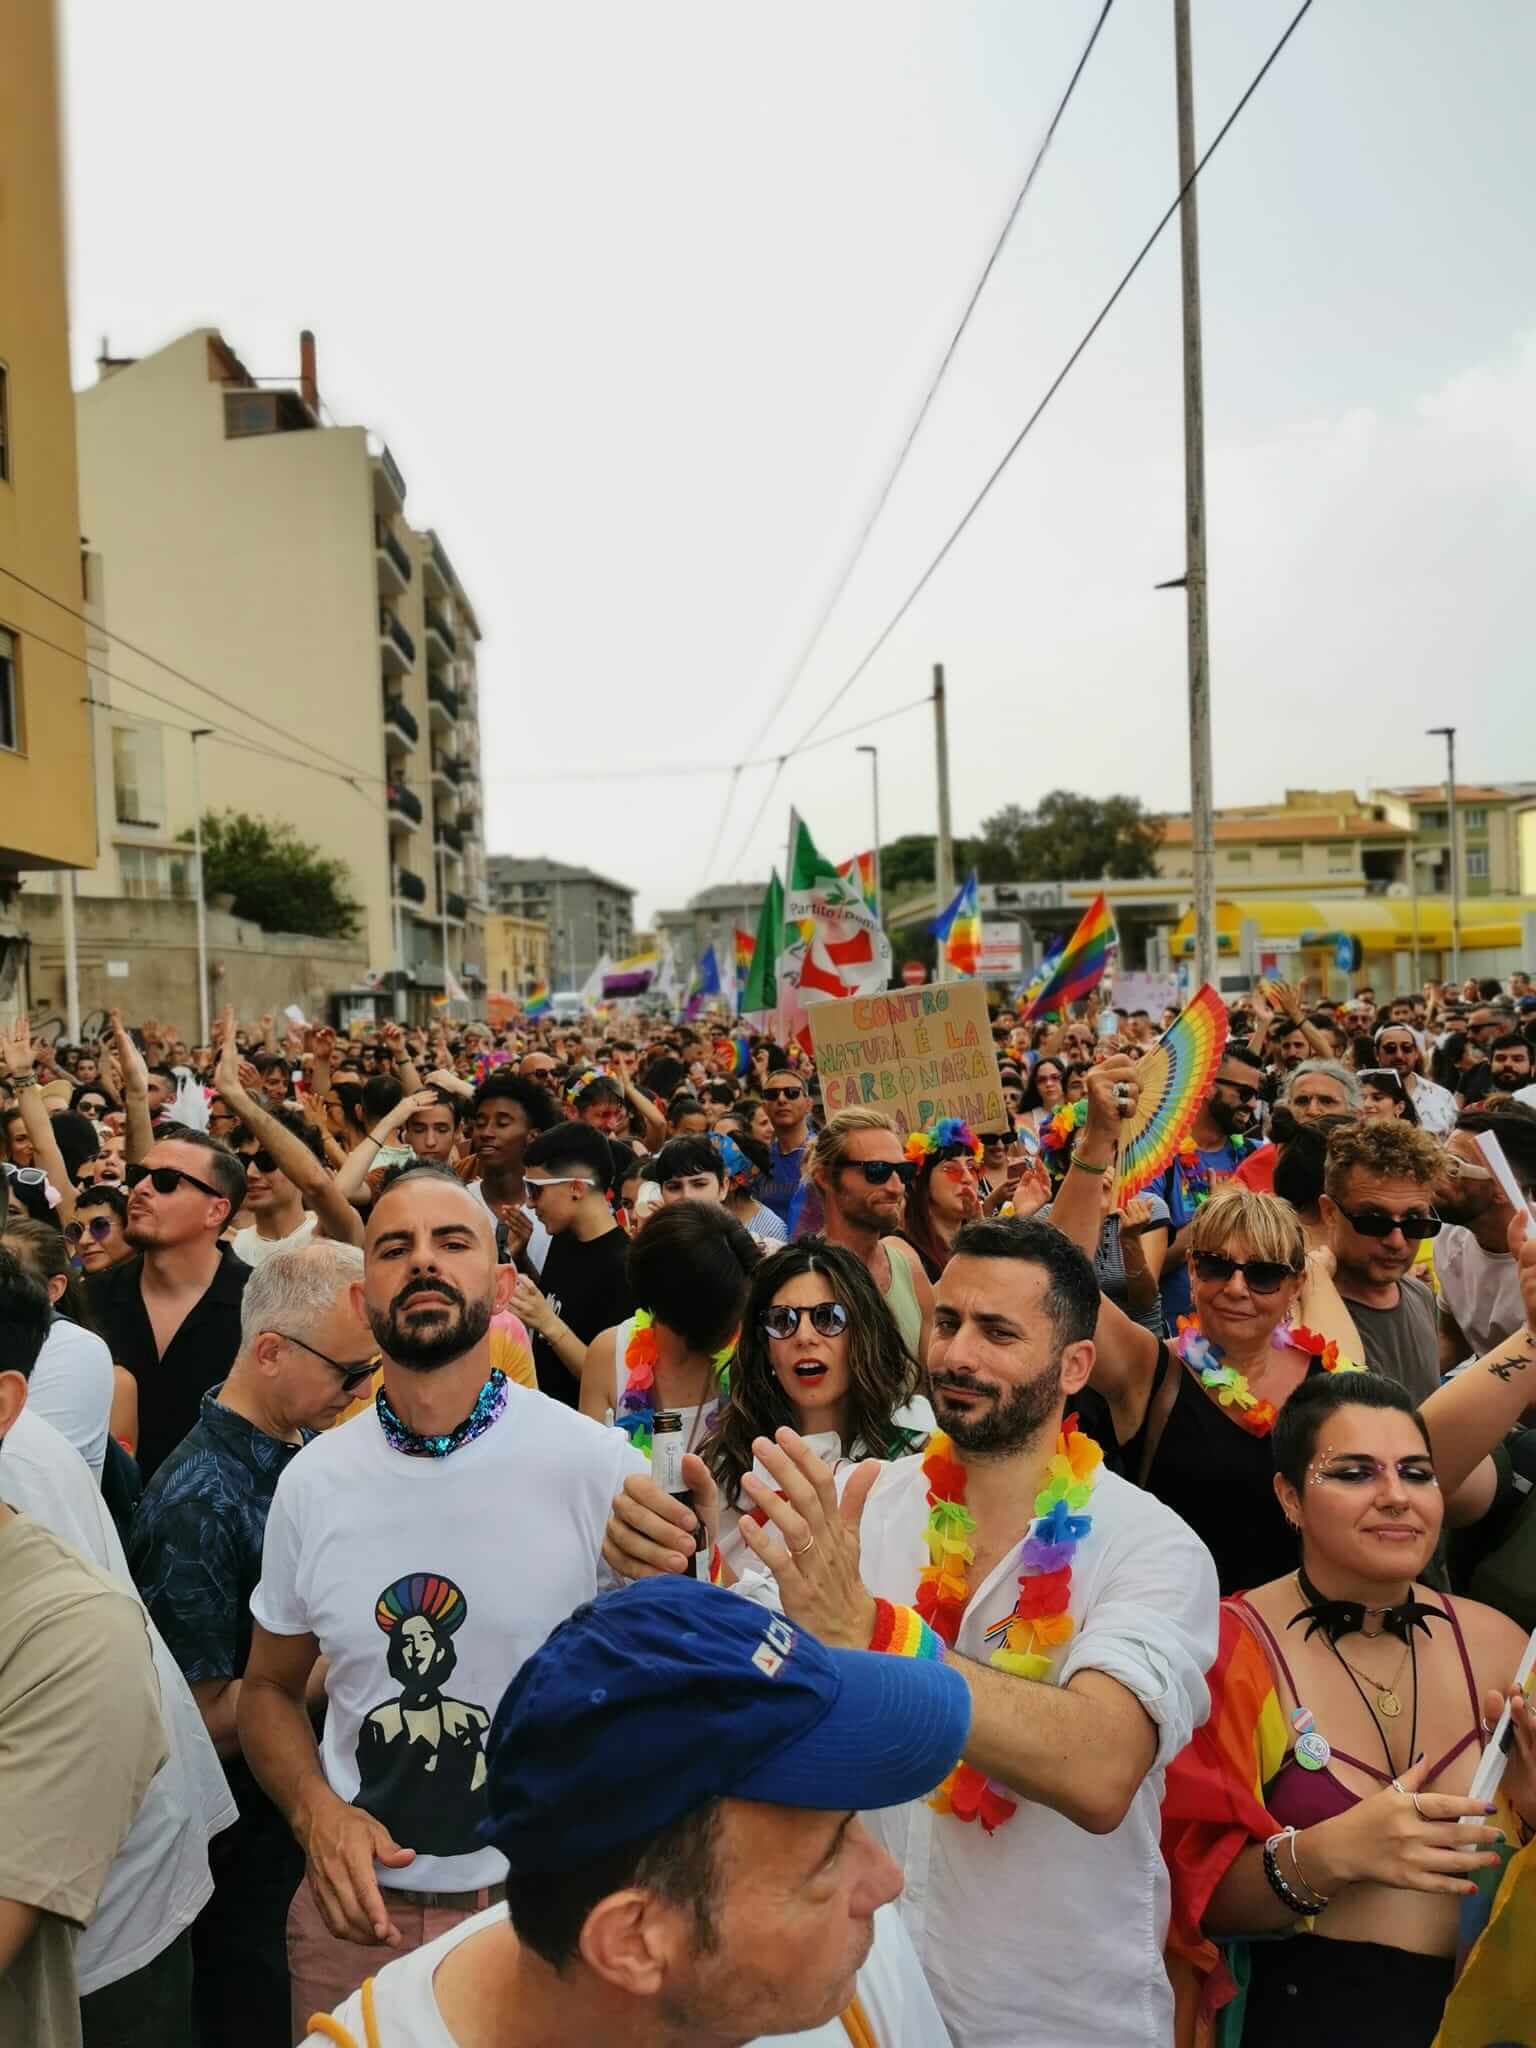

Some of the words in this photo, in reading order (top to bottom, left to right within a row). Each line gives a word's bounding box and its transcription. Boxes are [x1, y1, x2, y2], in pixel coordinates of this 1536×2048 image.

[790, 903, 834, 918] Partito
[1025, 884, 1062, 908] eni
[852, 991, 949, 1031] CONTRO
[817, 1037, 906, 1073] NATURA
[944, 1021, 980, 1049] LA
[825, 1052, 989, 1110] CARBONARA
[918, 1092, 1001, 1129] PANNA
